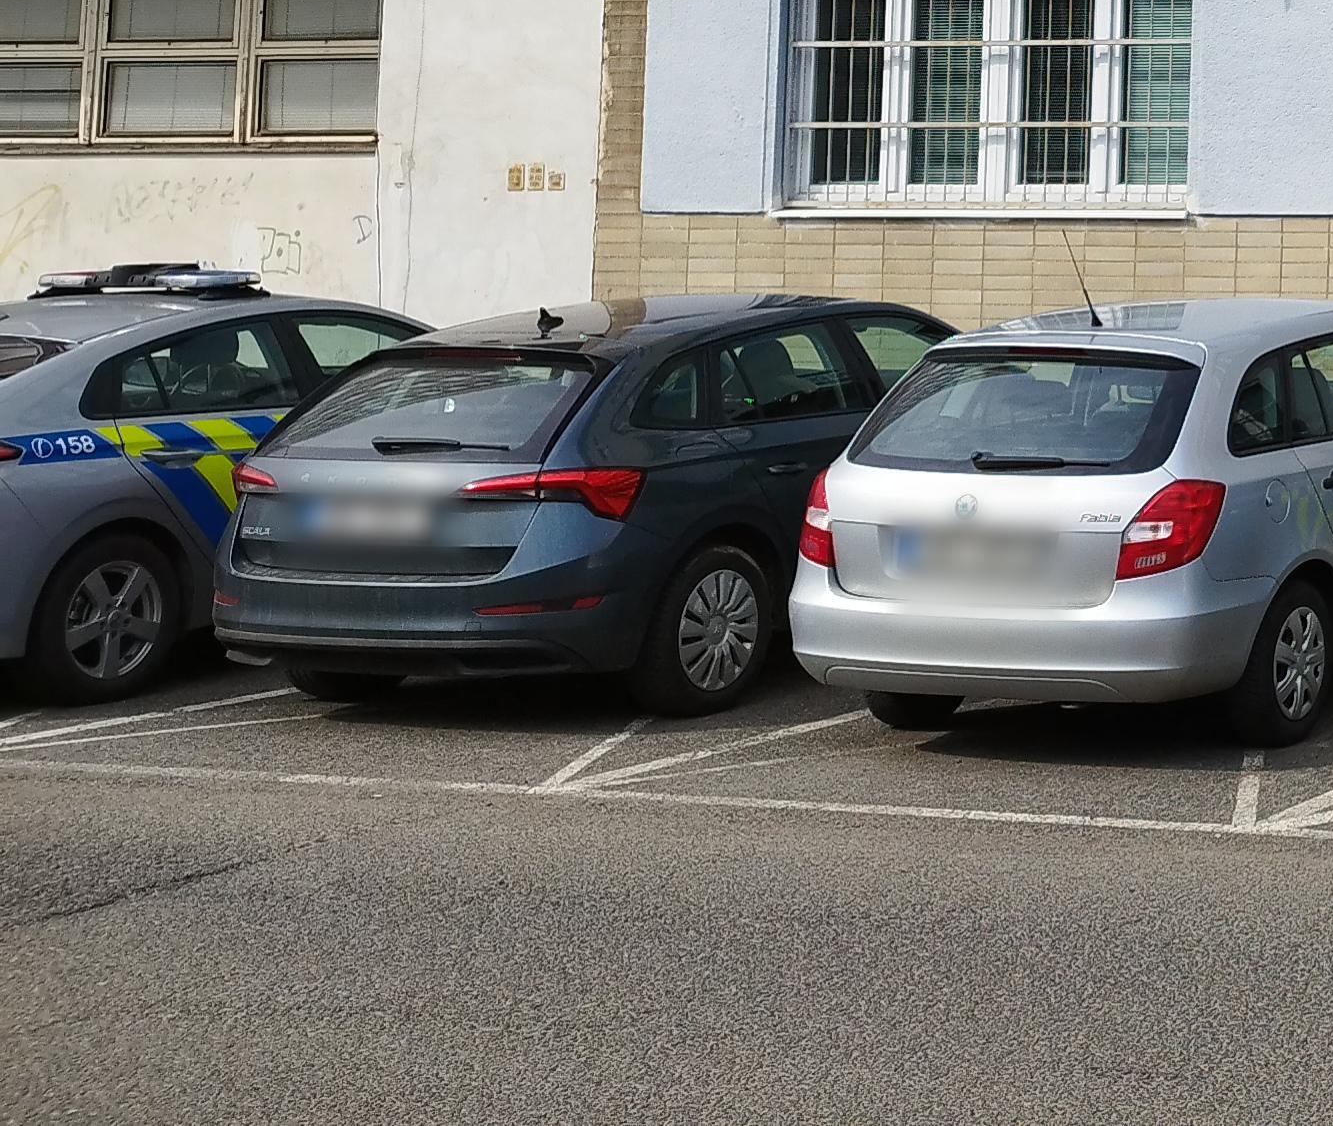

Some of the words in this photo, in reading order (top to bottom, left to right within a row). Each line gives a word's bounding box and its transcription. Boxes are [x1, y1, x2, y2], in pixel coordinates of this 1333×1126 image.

[56, 435, 95, 455] 158
[1080, 513, 1121, 523] Fabia
[242, 526, 270, 537] SCALA
